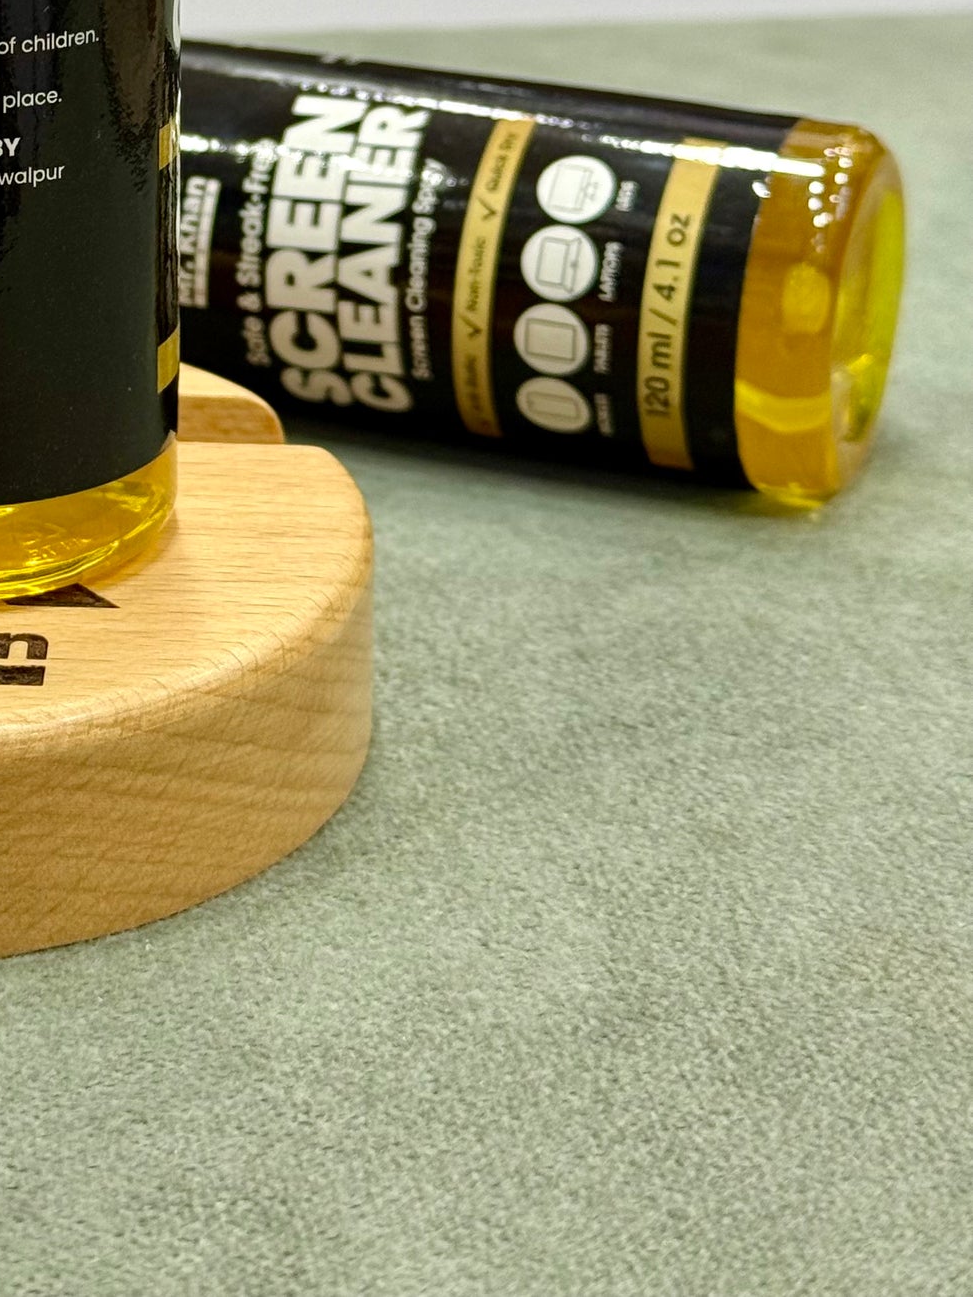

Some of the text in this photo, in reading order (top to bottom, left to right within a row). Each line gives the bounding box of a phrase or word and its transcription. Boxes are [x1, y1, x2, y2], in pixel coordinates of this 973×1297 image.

[21, 29, 100, 53] children.
[2, 90, 63, 114] place.
[181, 176, 207, 256] Khan
[265, 95, 368, 406] SCREEN
[338, 105, 430, 411] CLEANER
[405, 216, 436, 313] Cleaning
[236, 291, 262, 313] &
[644, 213, 689, 419] 120 ml / 4.1 oz
[240, 318, 271, 366] Safe
[408, 316, 434, 379] Screen
